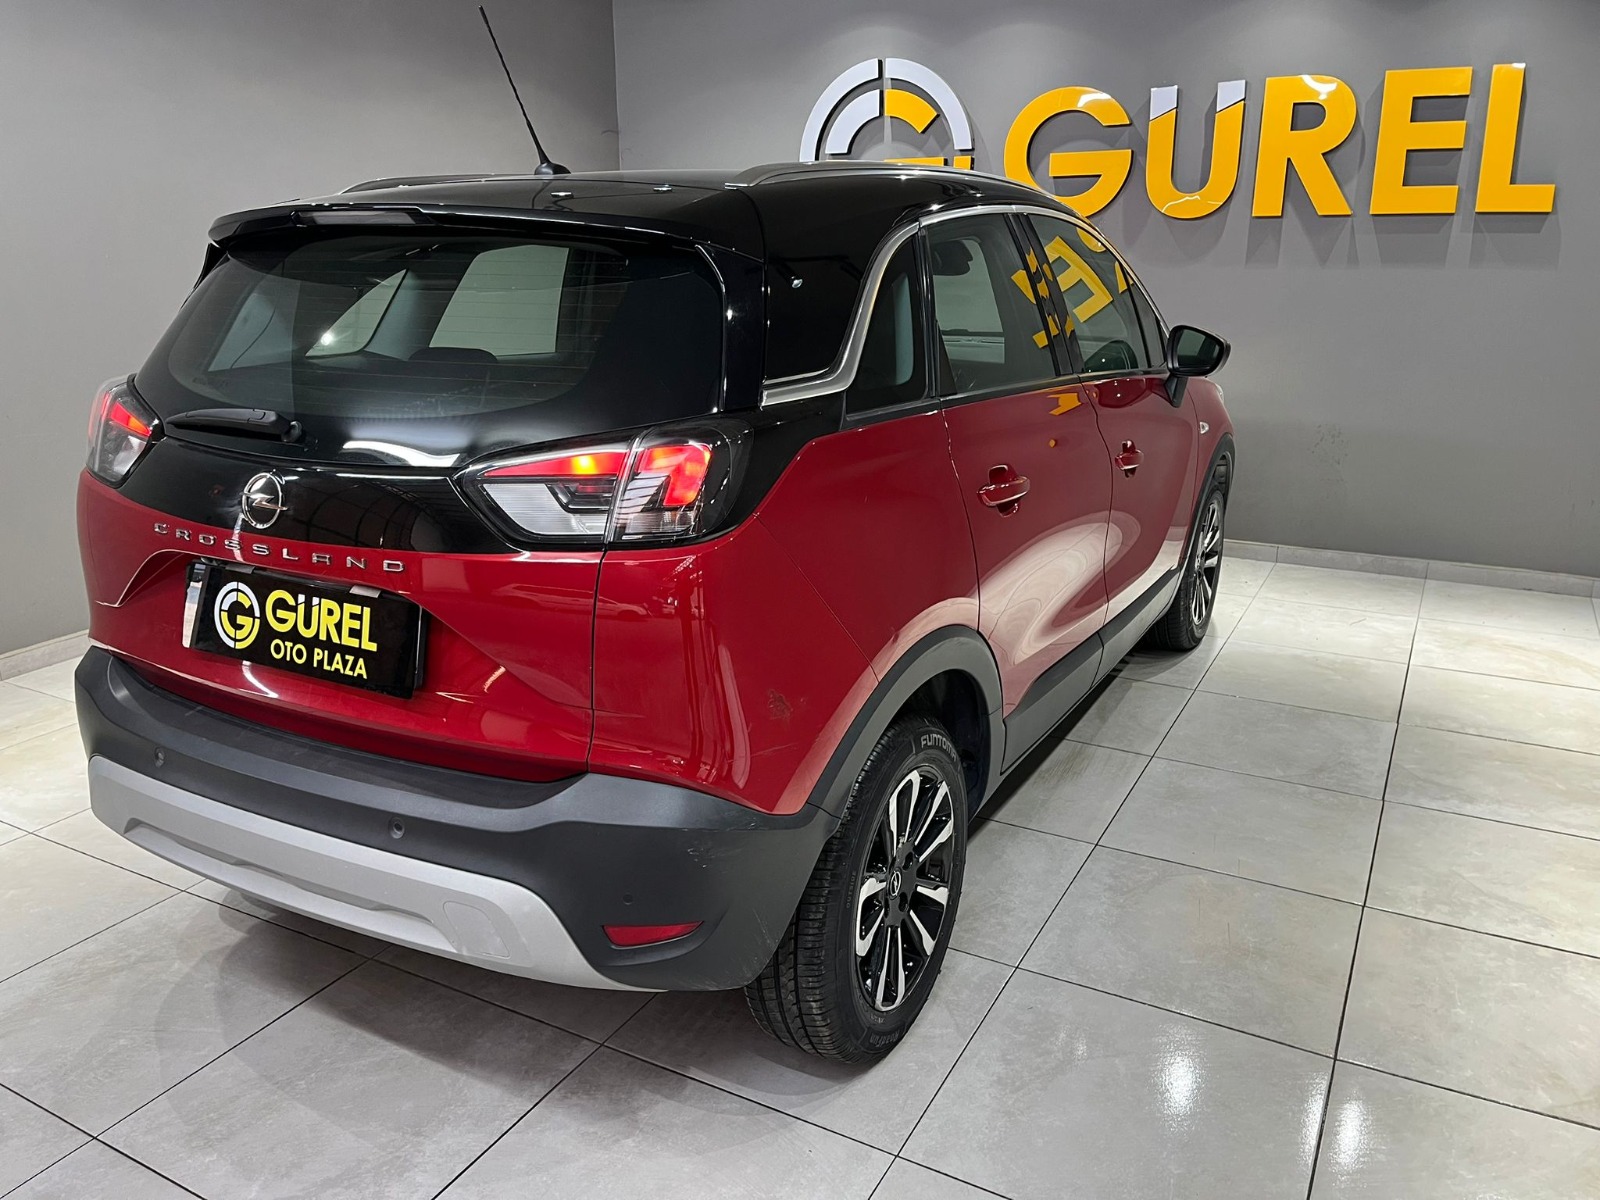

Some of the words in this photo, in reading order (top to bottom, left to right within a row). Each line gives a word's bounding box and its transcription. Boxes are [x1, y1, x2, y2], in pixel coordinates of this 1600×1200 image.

[154, 523, 405, 572] CROSSLAND
[270, 639, 307, 664] OTO
[313, 647, 368, 679] PLAZA
